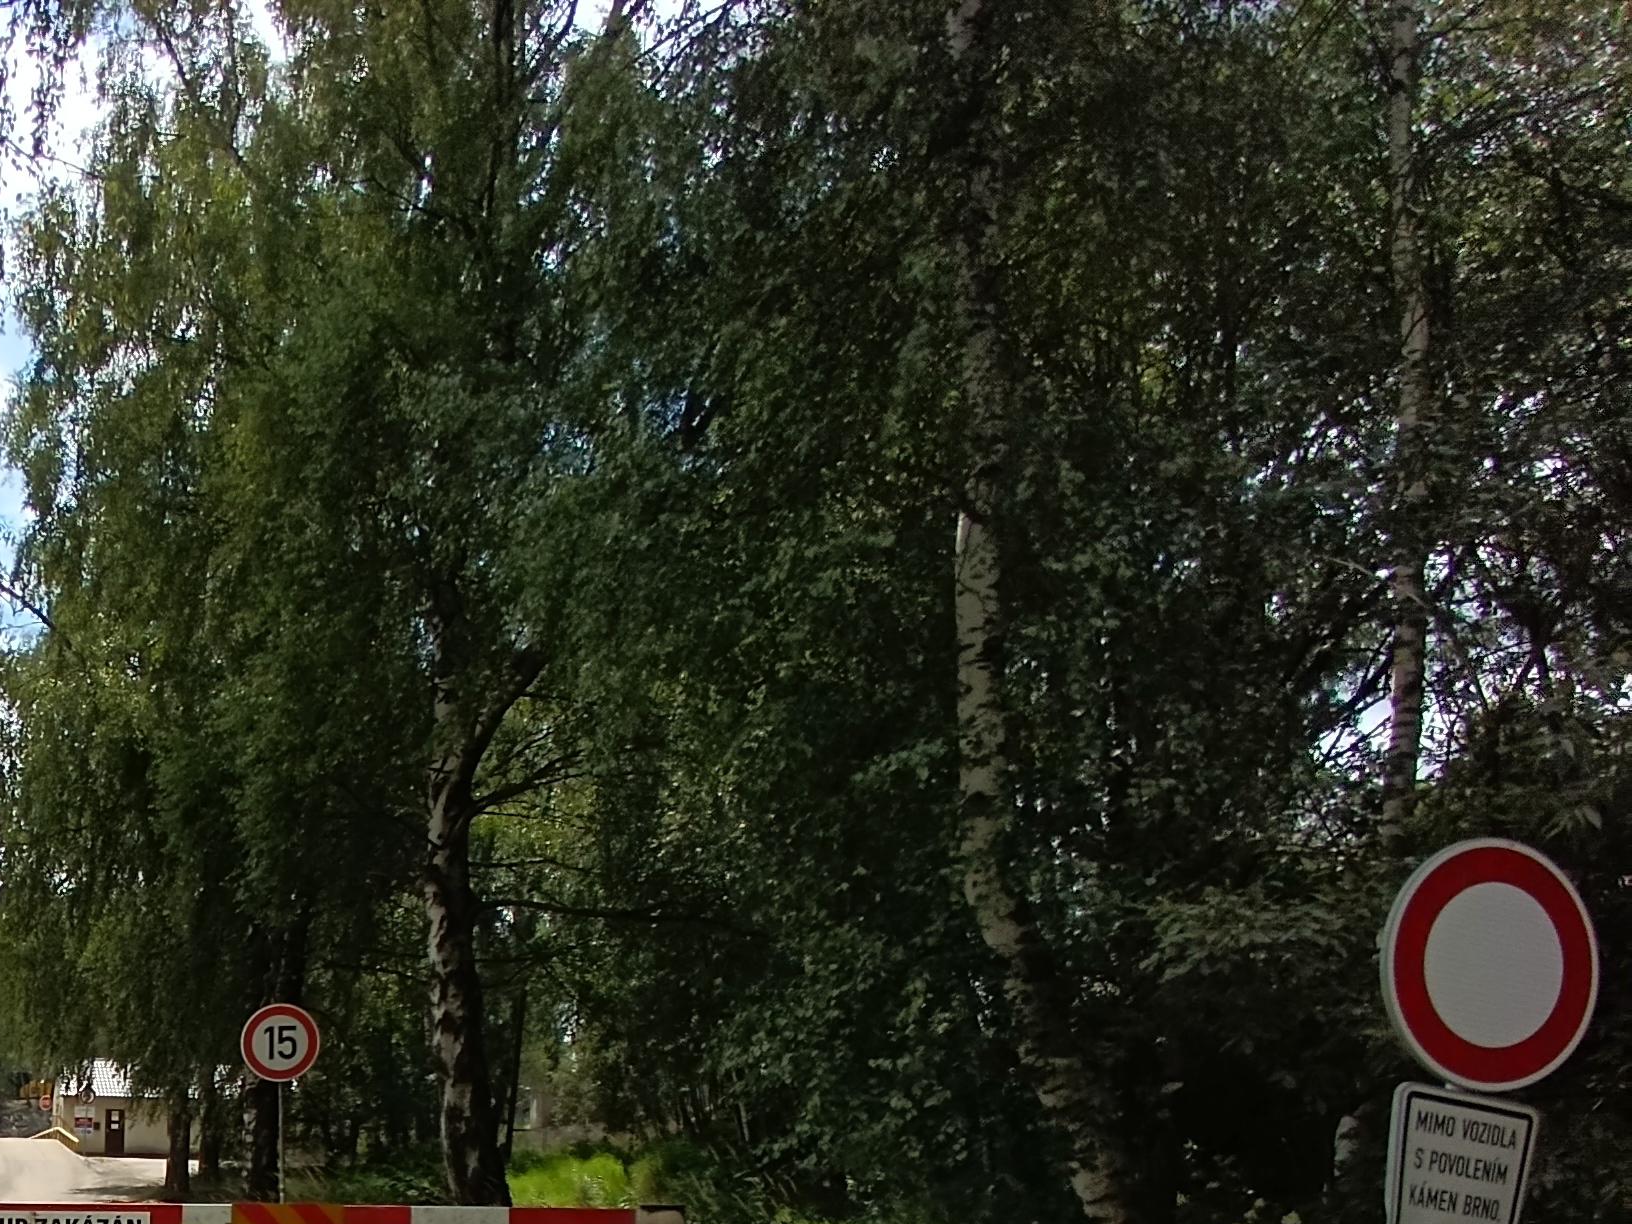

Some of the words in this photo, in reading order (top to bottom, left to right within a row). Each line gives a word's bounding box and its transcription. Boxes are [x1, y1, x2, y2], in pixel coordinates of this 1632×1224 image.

[264, 1025, 297, 1060] 15
[1415, 1110, 1456, 1137] MIMO
[1462, 1117, 1517, 1149] VOZIDLA
[1414, 1148, 1424, 1169] S
[1428, 1150, 1508, 1184] POVOLENÍM
[1408, 1181, 1458, 1213] KÁMEN
